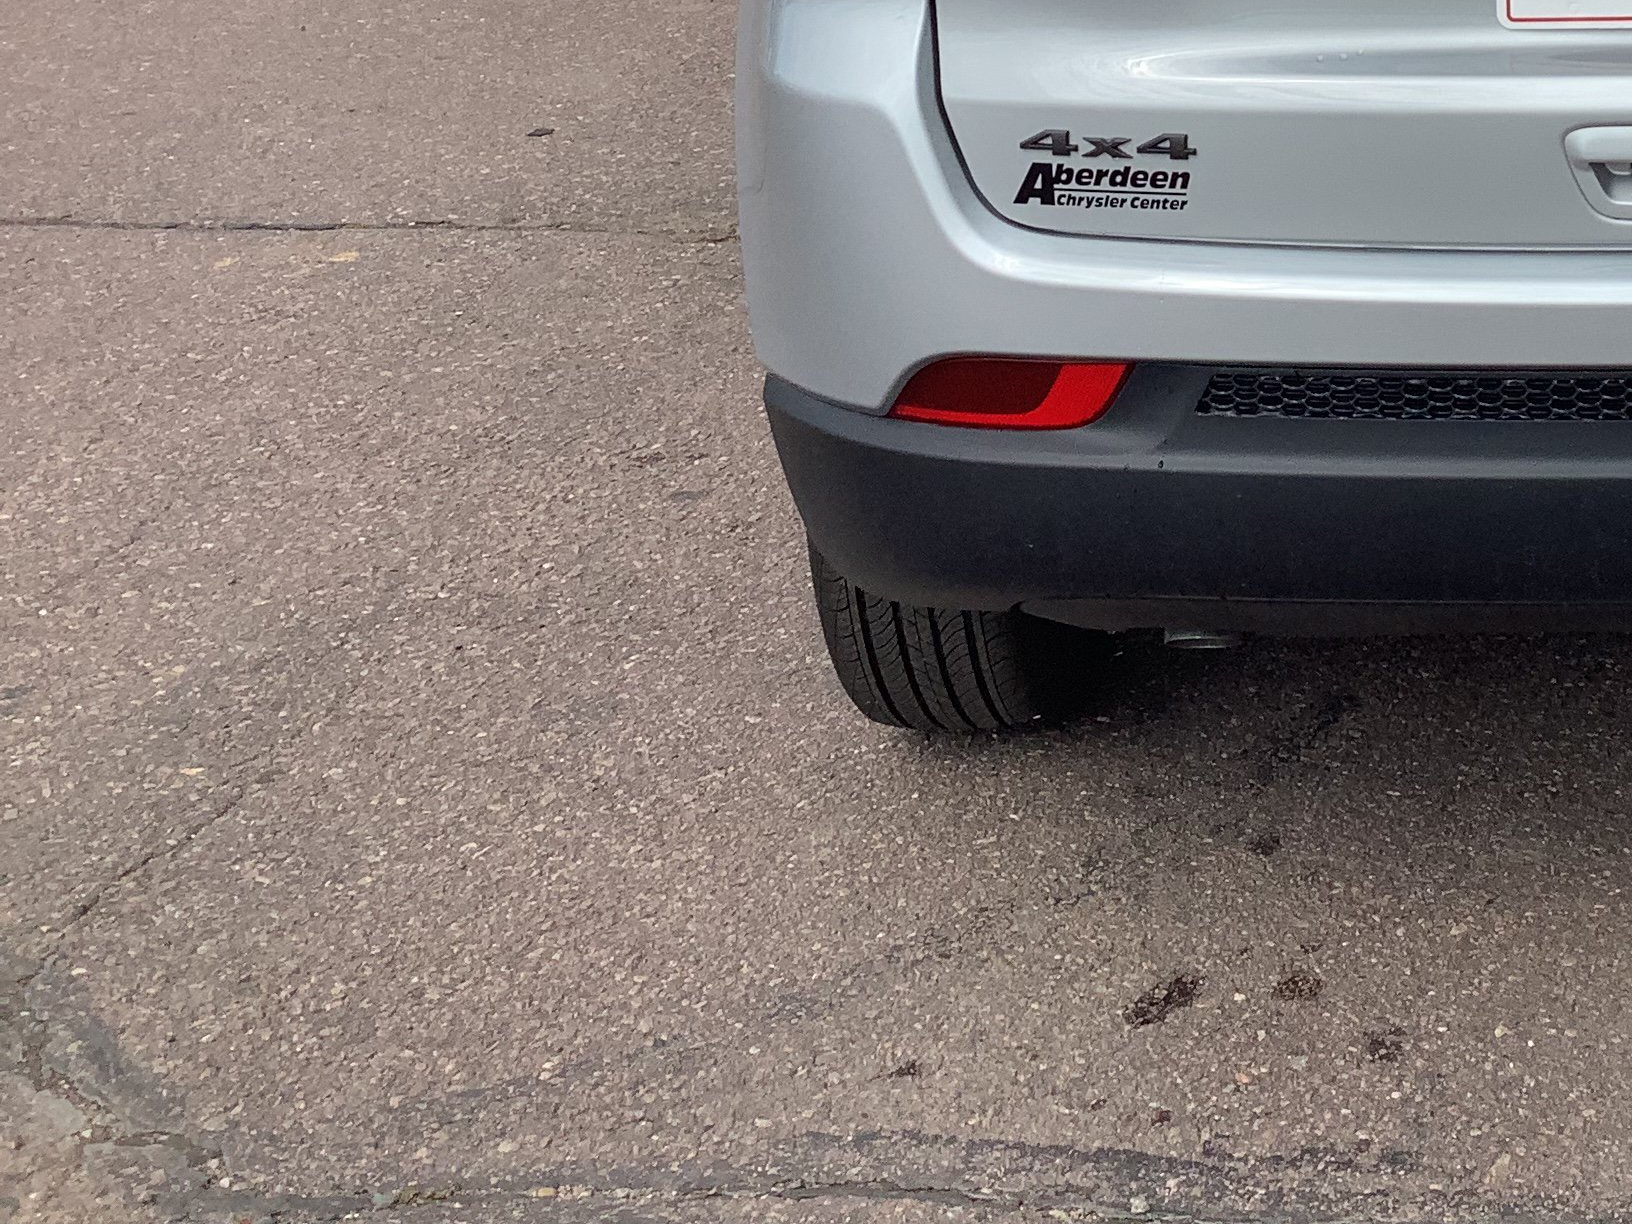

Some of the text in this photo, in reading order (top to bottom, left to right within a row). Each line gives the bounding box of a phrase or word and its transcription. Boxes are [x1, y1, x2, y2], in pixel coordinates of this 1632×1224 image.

[1019, 128, 1198, 160] 4x4
[1012, 162, 1190, 206] Aberdeen
[1056, 193, 1189, 211] Chrysler Center
